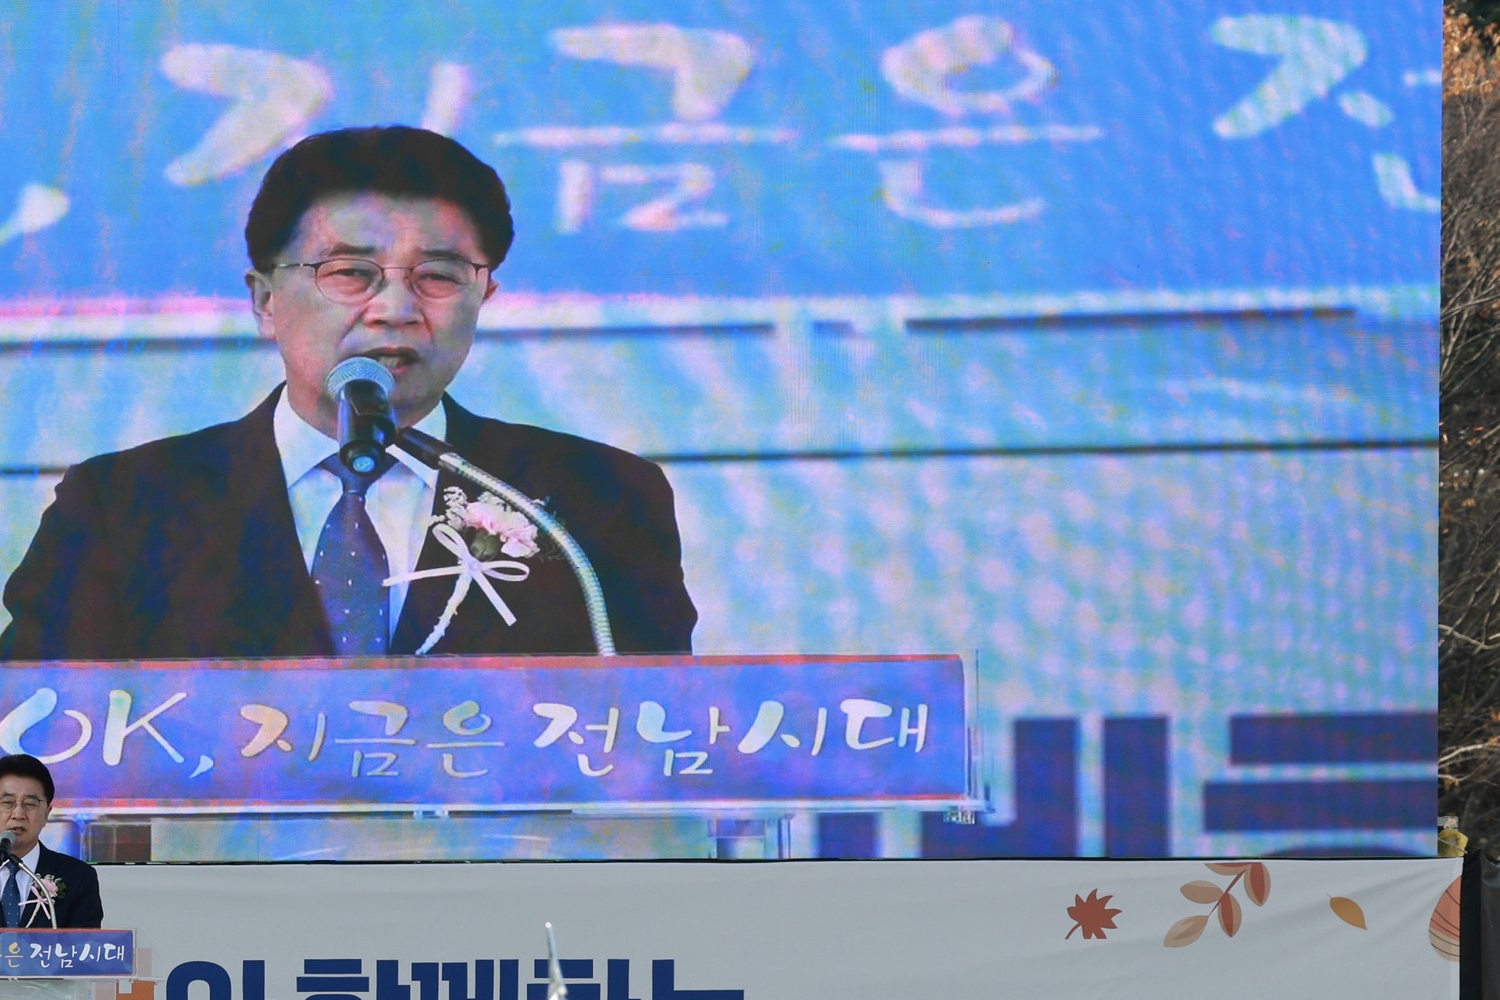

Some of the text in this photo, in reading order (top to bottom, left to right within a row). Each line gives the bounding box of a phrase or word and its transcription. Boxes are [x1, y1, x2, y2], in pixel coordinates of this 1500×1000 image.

[240, 699, 506, 778] 지금은
[533, 698, 928, 777] 전남시대
[30, 942, 125, 968] 전남시대
